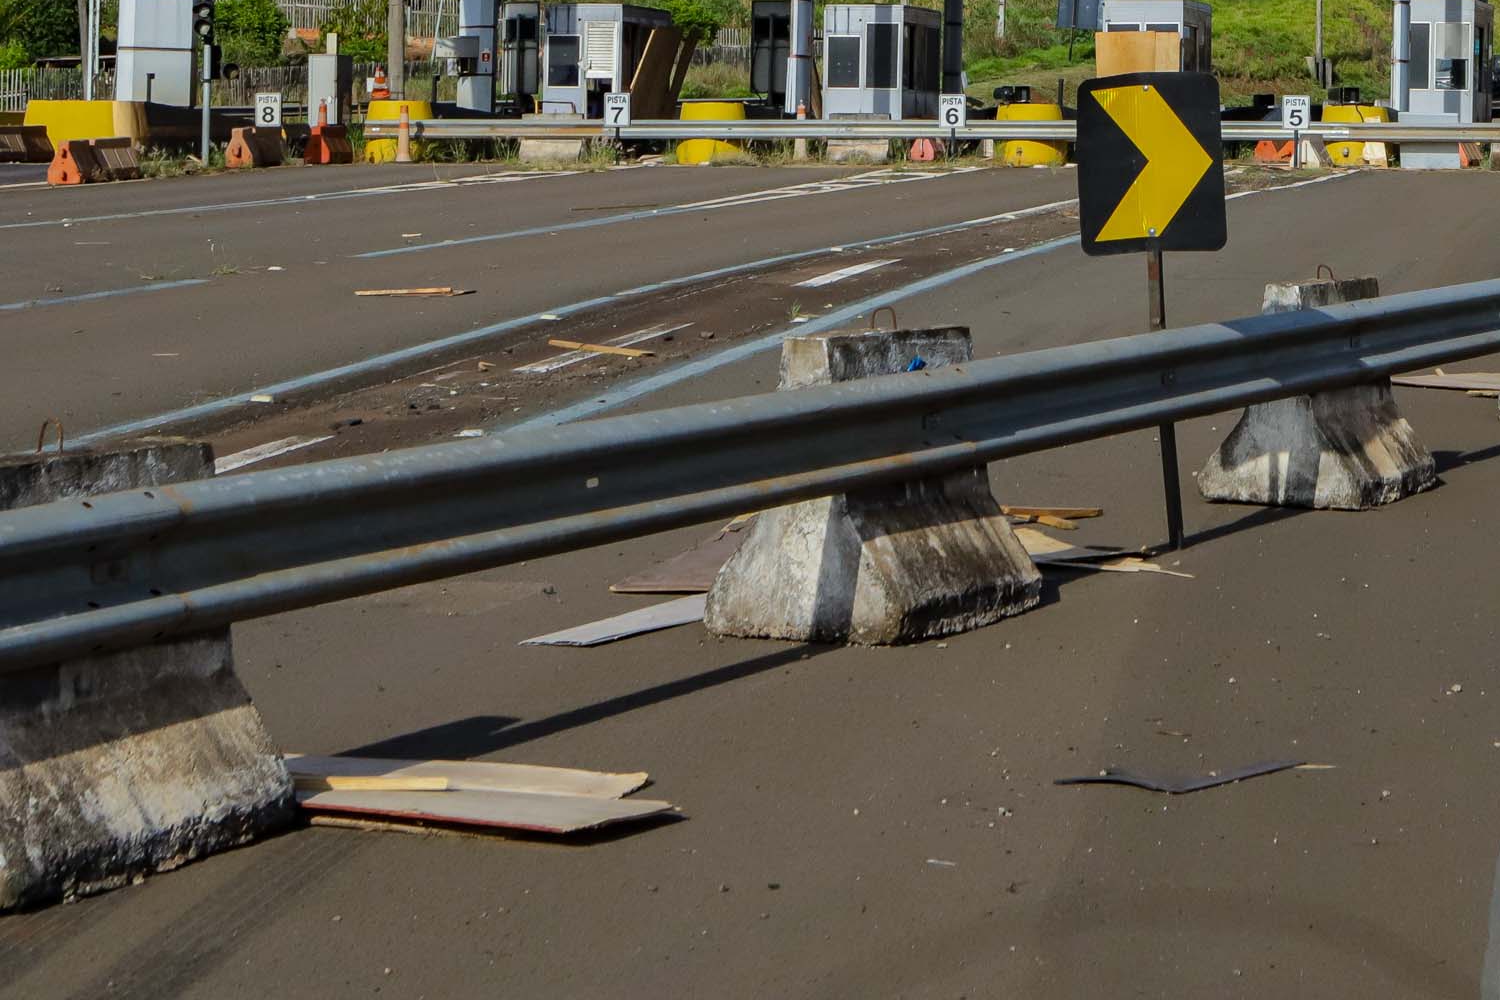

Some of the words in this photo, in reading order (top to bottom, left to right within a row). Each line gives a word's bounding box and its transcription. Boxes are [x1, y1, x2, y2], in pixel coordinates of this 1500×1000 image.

[607, 96, 627, 104] PISTA
[942, 97, 962, 105] PISTA
[262, 106, 274, 123] 8
[611, 107, 624, 124] 7
[946, 108, 959, 125] 6
[1289, 109, 1303, 126] 5
